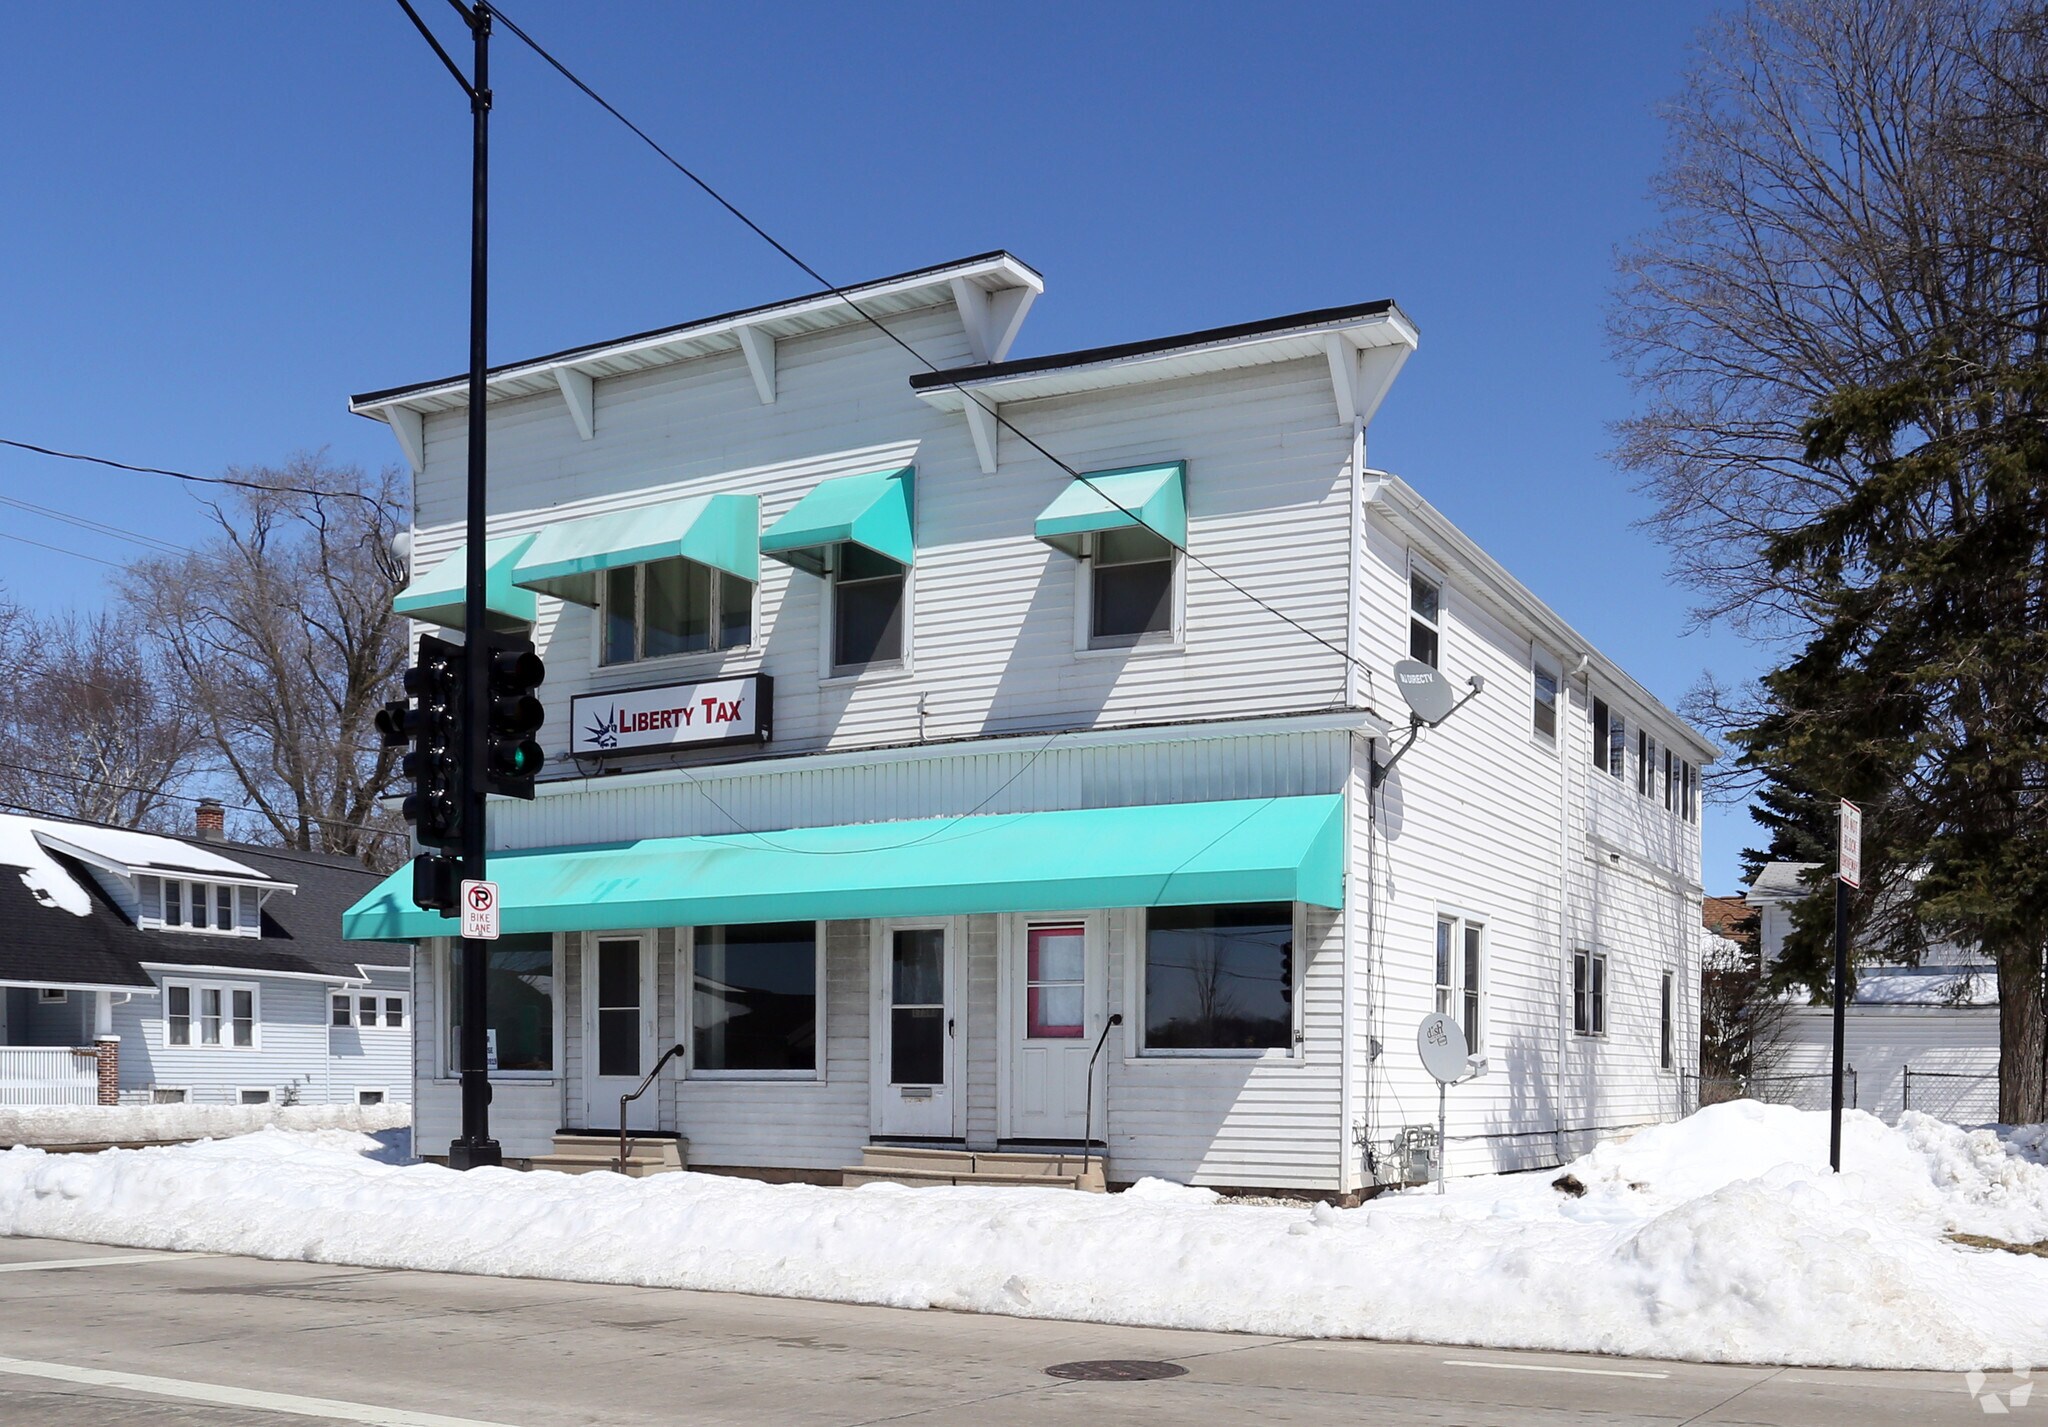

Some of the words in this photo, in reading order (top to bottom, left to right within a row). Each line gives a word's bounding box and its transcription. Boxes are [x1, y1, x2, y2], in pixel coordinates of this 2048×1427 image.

[619, 707, 694, 734] LIBERTY
[701, 697, 742, 724] TAX
[470, 912, 491, 923] BIKE
[469, 922, 491, 934] LANE
